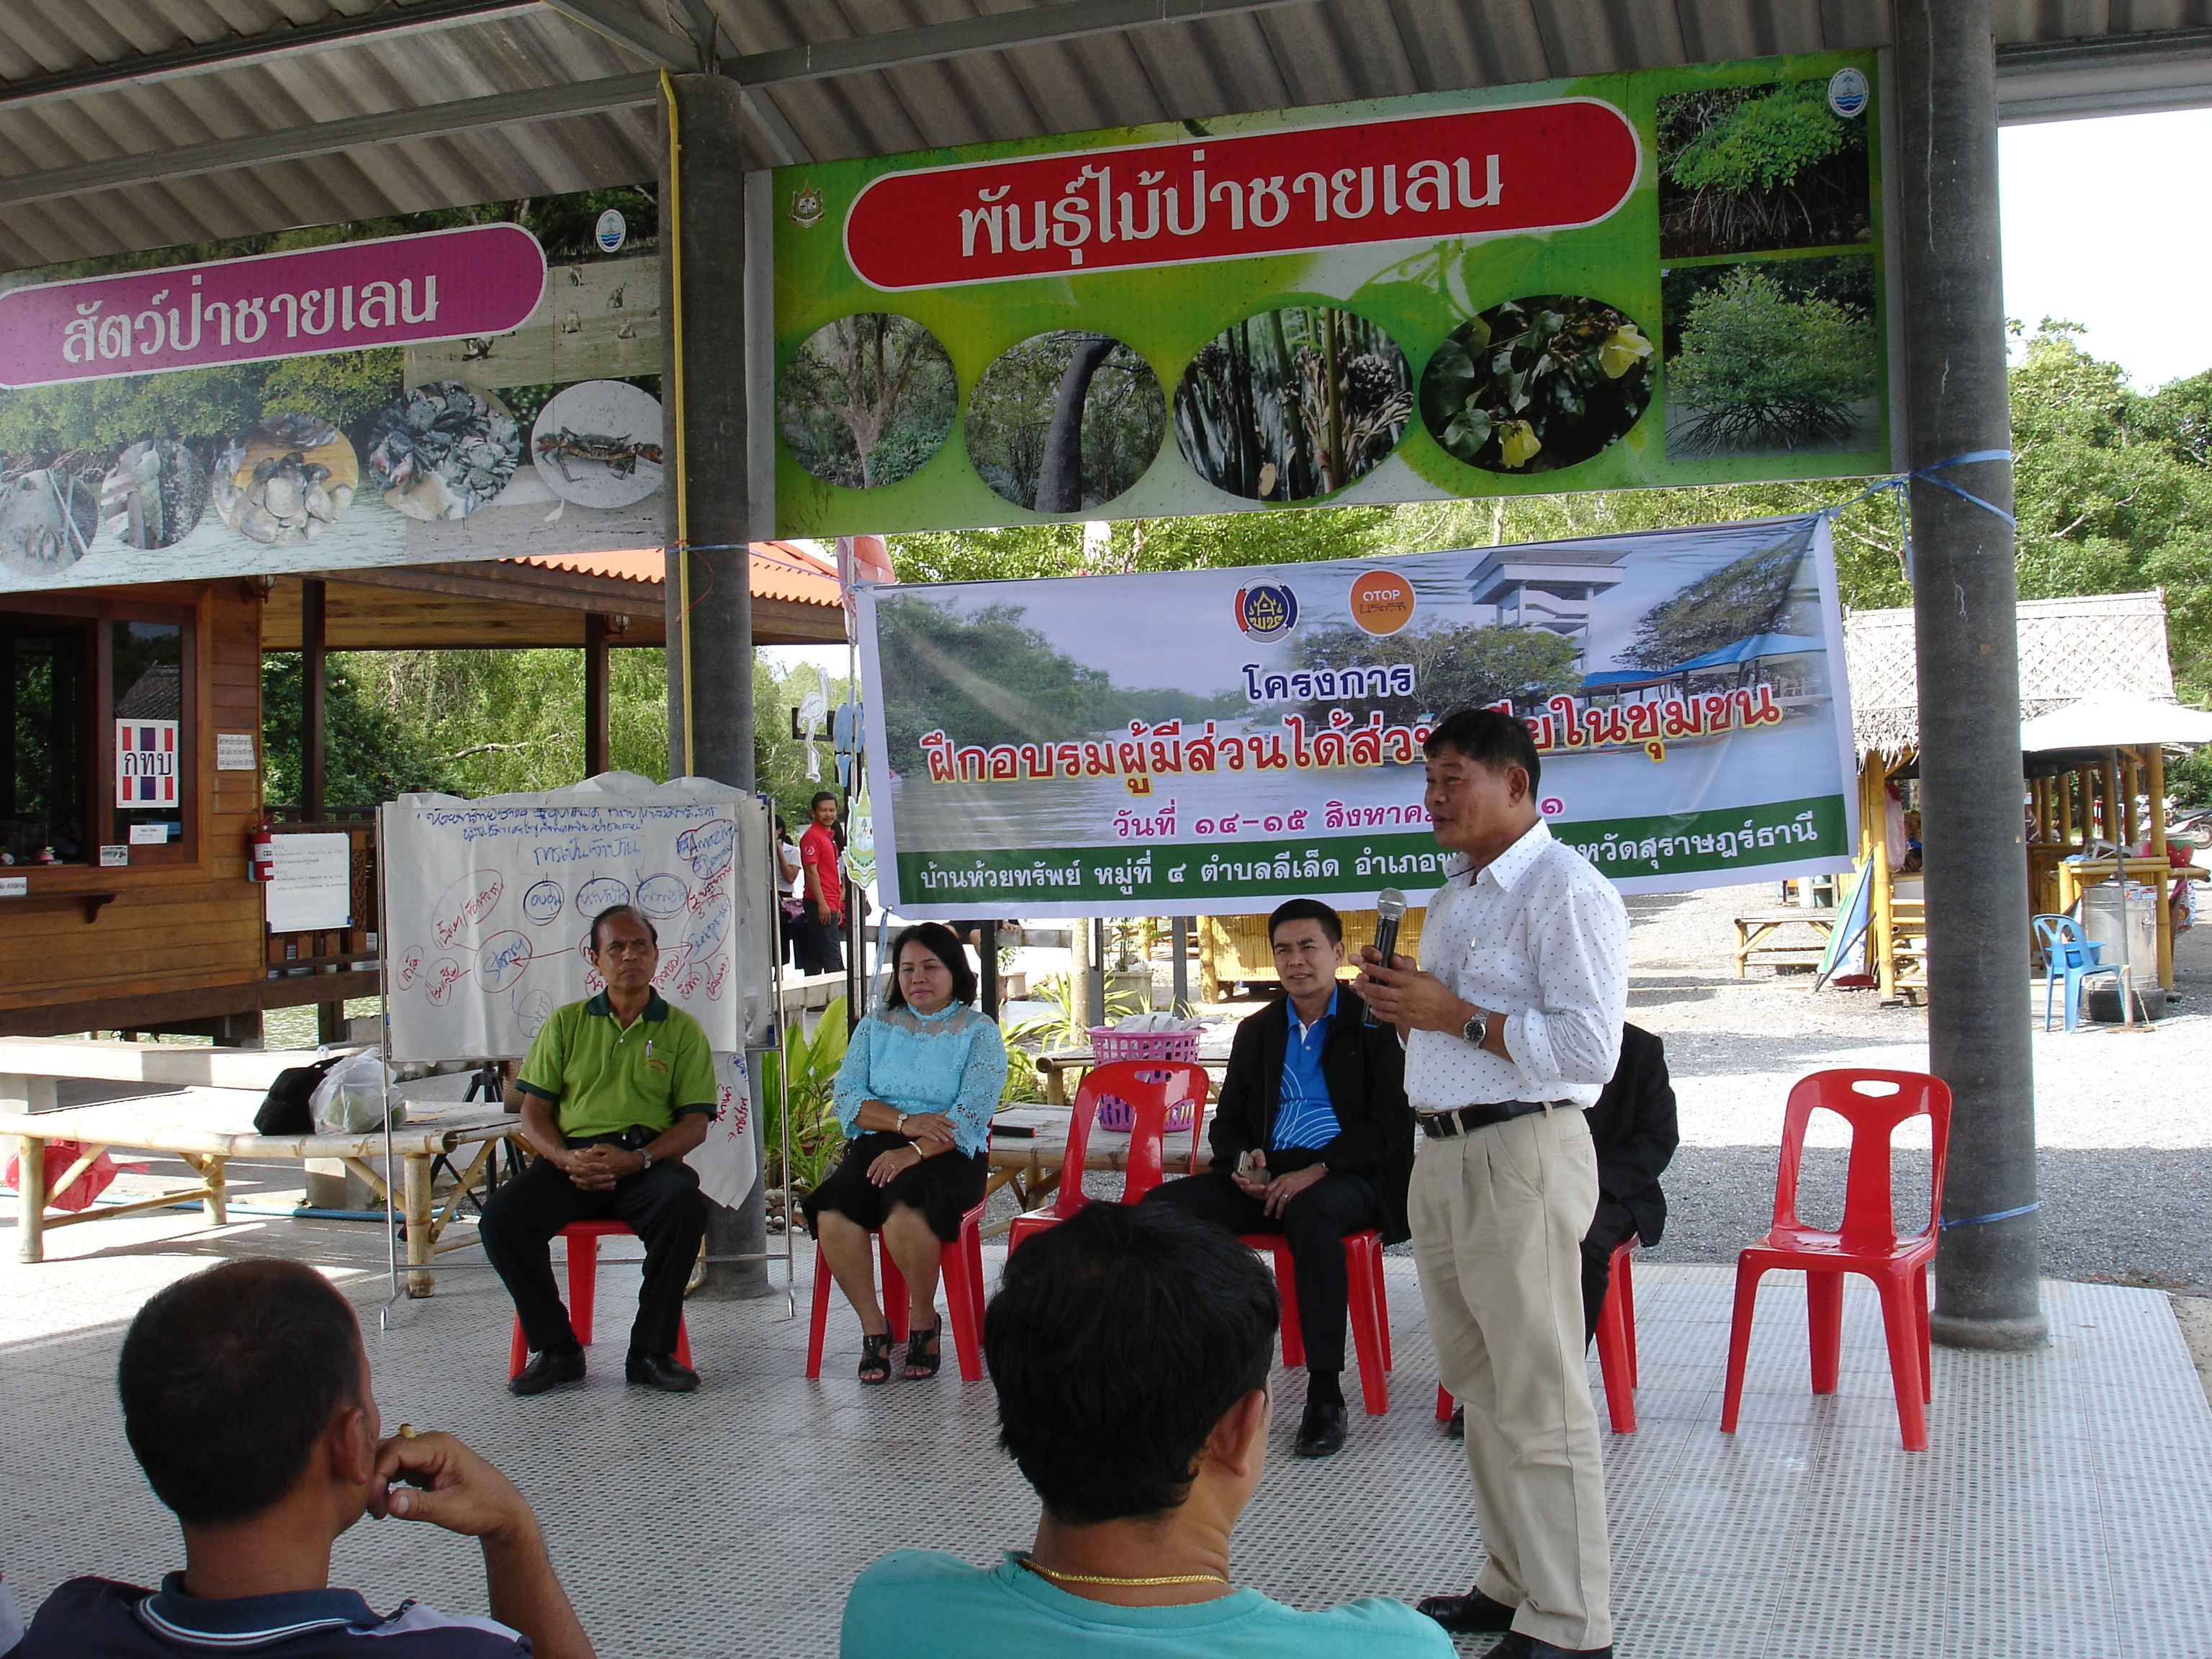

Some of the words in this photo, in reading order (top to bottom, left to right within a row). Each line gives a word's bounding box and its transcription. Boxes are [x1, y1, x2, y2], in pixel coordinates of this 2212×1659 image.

[958, 149, 1503, 265] พันธุ์ไม้ป่าชายเลน
[63, 274, 439, 363] สัตว์ป่าชายเลน
[1363, 590, 1400, 601] OTOP
[1244, 665, 1412, 701] โครงการ
[124, 752, 172, 775] กทบ
[1113, 800, 1176, 836] วันที่
[1195, 809, 1308, 834] ๑๔-๑๕
[1325, 801, 1432, 828] สิงหาค
[921, 860, 1081, 889] บ้านห้วยทรัพย์
[1094, 850, 1152, 895] หมู่ที่
[1167, 863, 1187, 884] ๔
[1200, 848, 1339, 883] ตำบลลีเล็ด
[1567, 810, 1817, 869] หวัดสุราษฎร์ธานี
